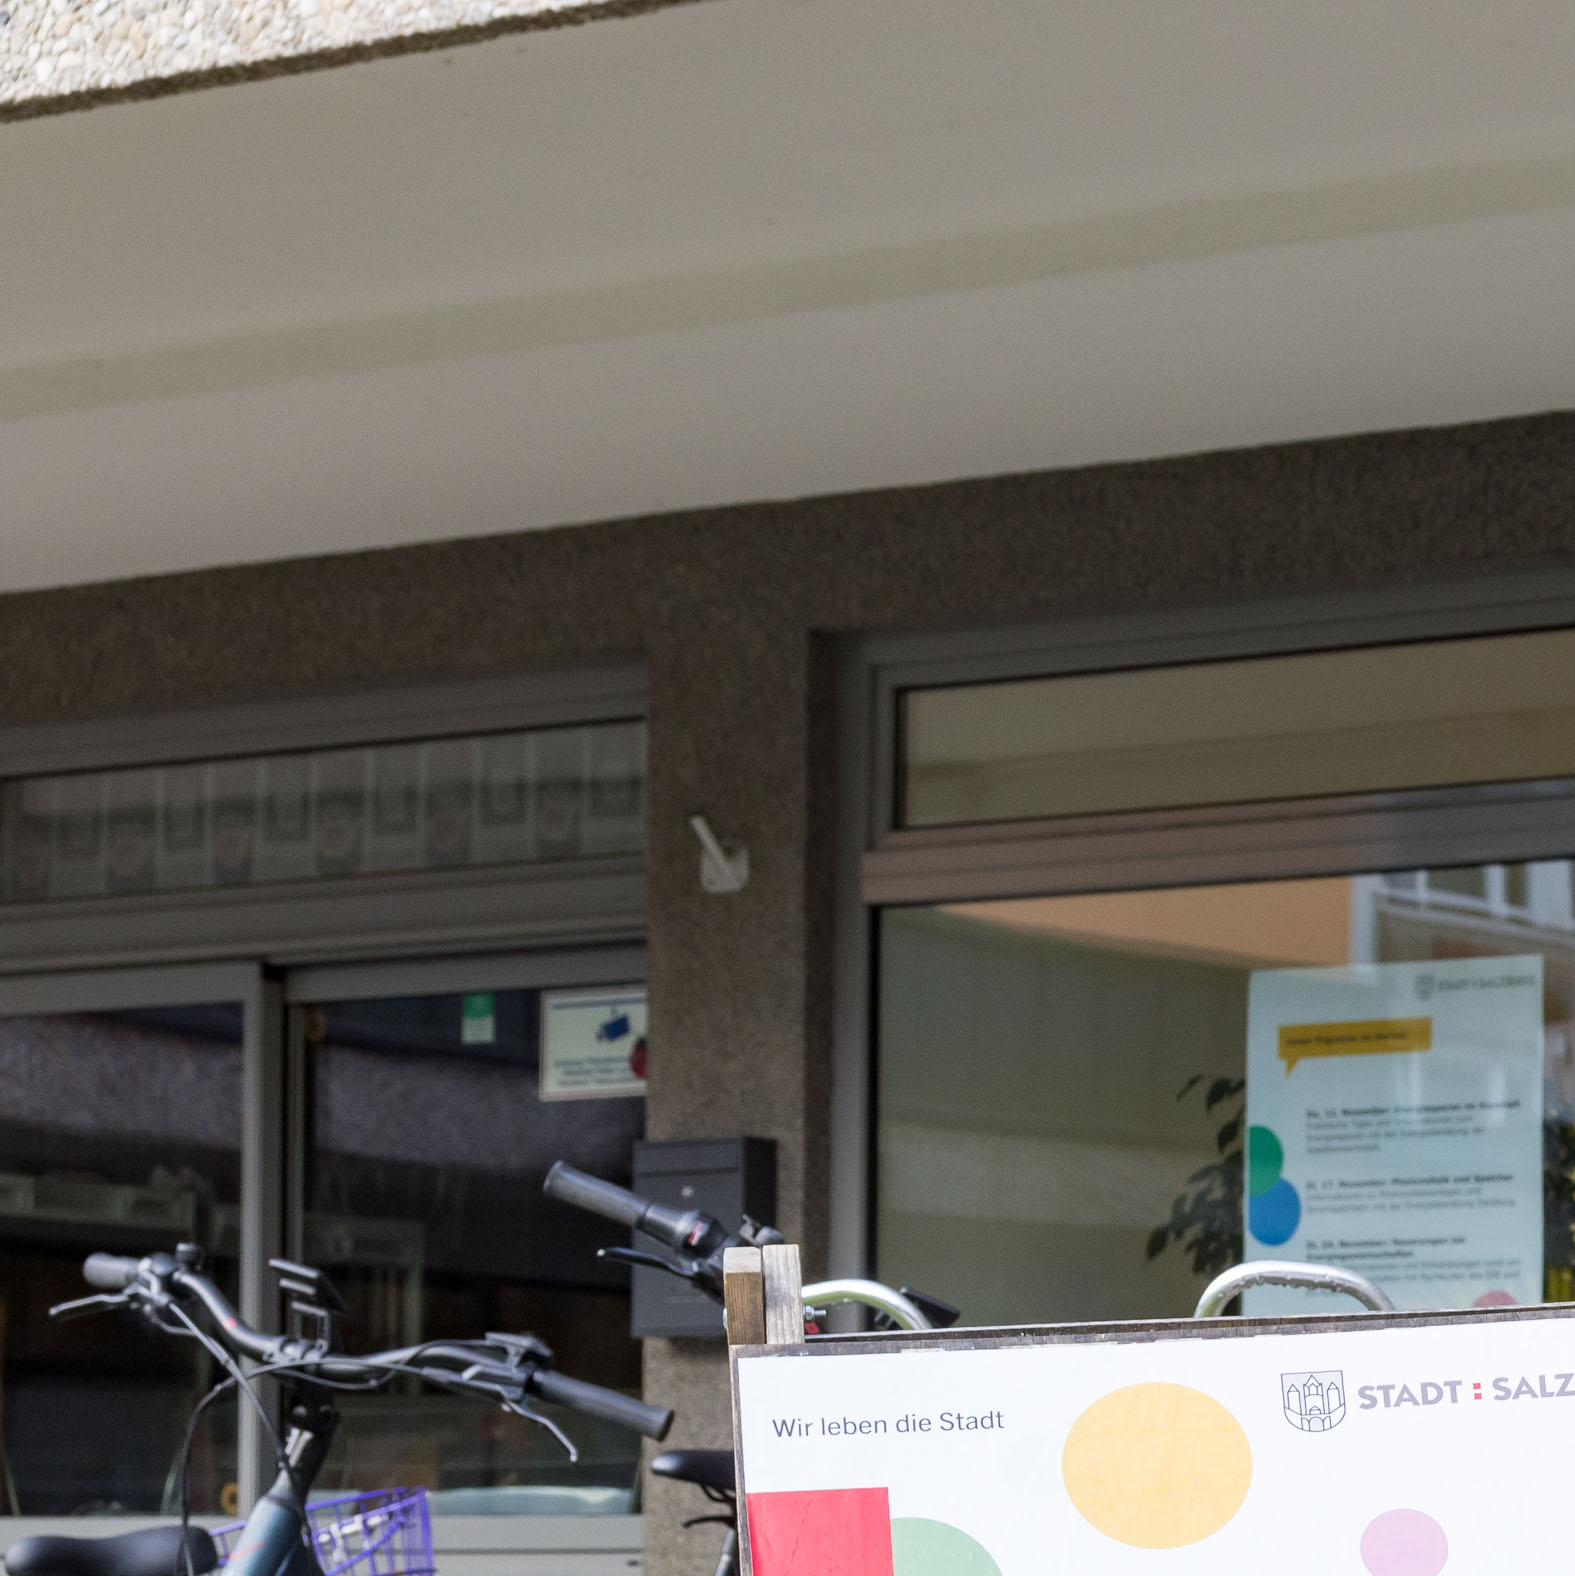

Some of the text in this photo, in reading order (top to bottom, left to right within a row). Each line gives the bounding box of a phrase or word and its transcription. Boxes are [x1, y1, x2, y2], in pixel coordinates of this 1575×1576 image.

[1358, 1380, 1462, 1410] STADT
[772, 1410, 1005, 1438] Wir leben die Stadt
